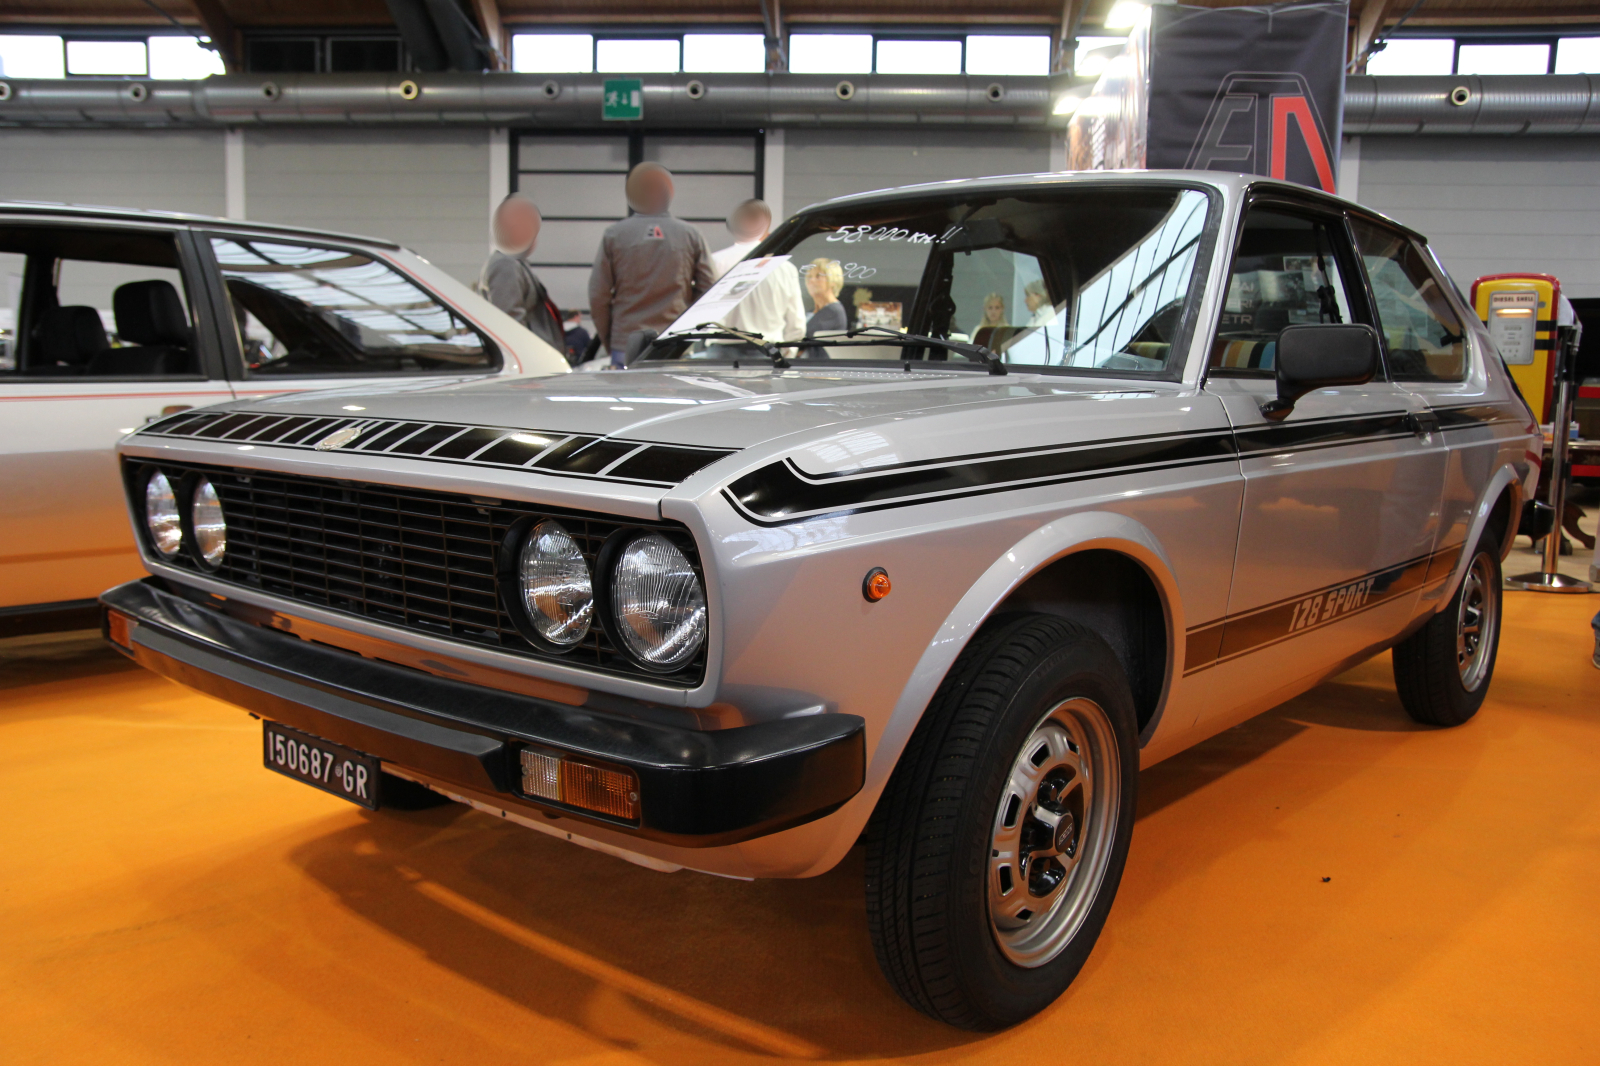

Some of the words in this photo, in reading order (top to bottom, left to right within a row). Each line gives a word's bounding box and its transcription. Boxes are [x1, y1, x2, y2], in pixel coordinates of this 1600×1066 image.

[826, 225, 909, 243] 58.000
[1288, 595, 1324, 633] 128
[1321, 577, 1376, 621] SPORT
[268, 730, 334, 783] 150687
[342, 760, 367, 799] GR
